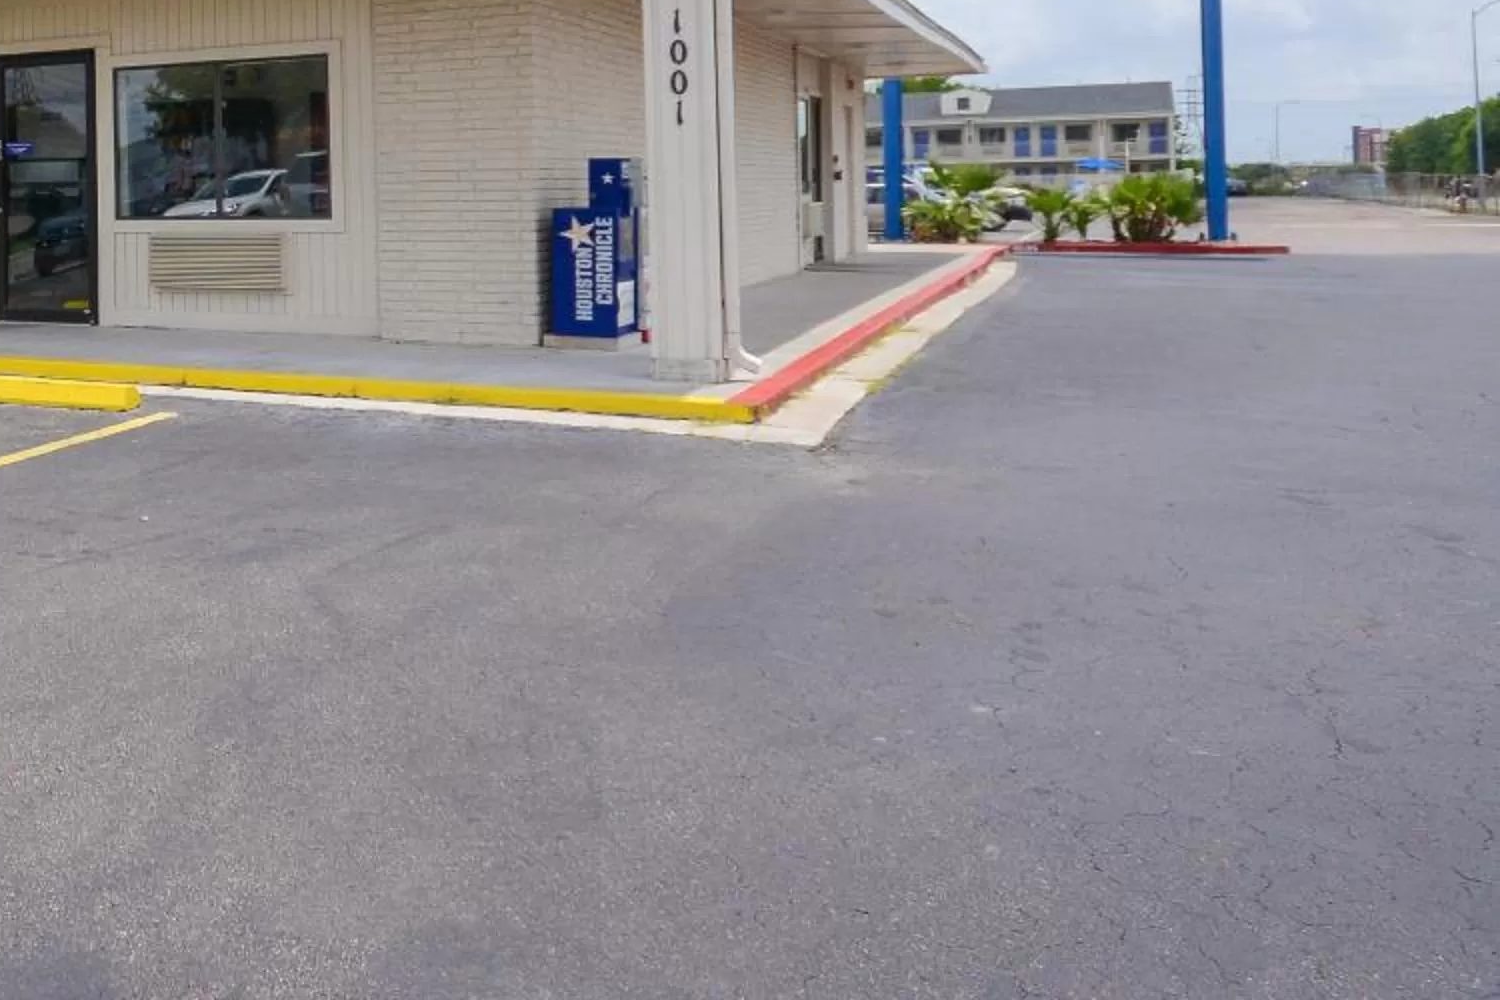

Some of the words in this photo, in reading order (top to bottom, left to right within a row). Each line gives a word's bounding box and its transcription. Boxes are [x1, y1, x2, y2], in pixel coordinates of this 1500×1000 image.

[668, 7, 689, 126] 1001
[575, 246, 594, 322] HOUSTON
[594, 215, 614, 305] CHRONICLE
